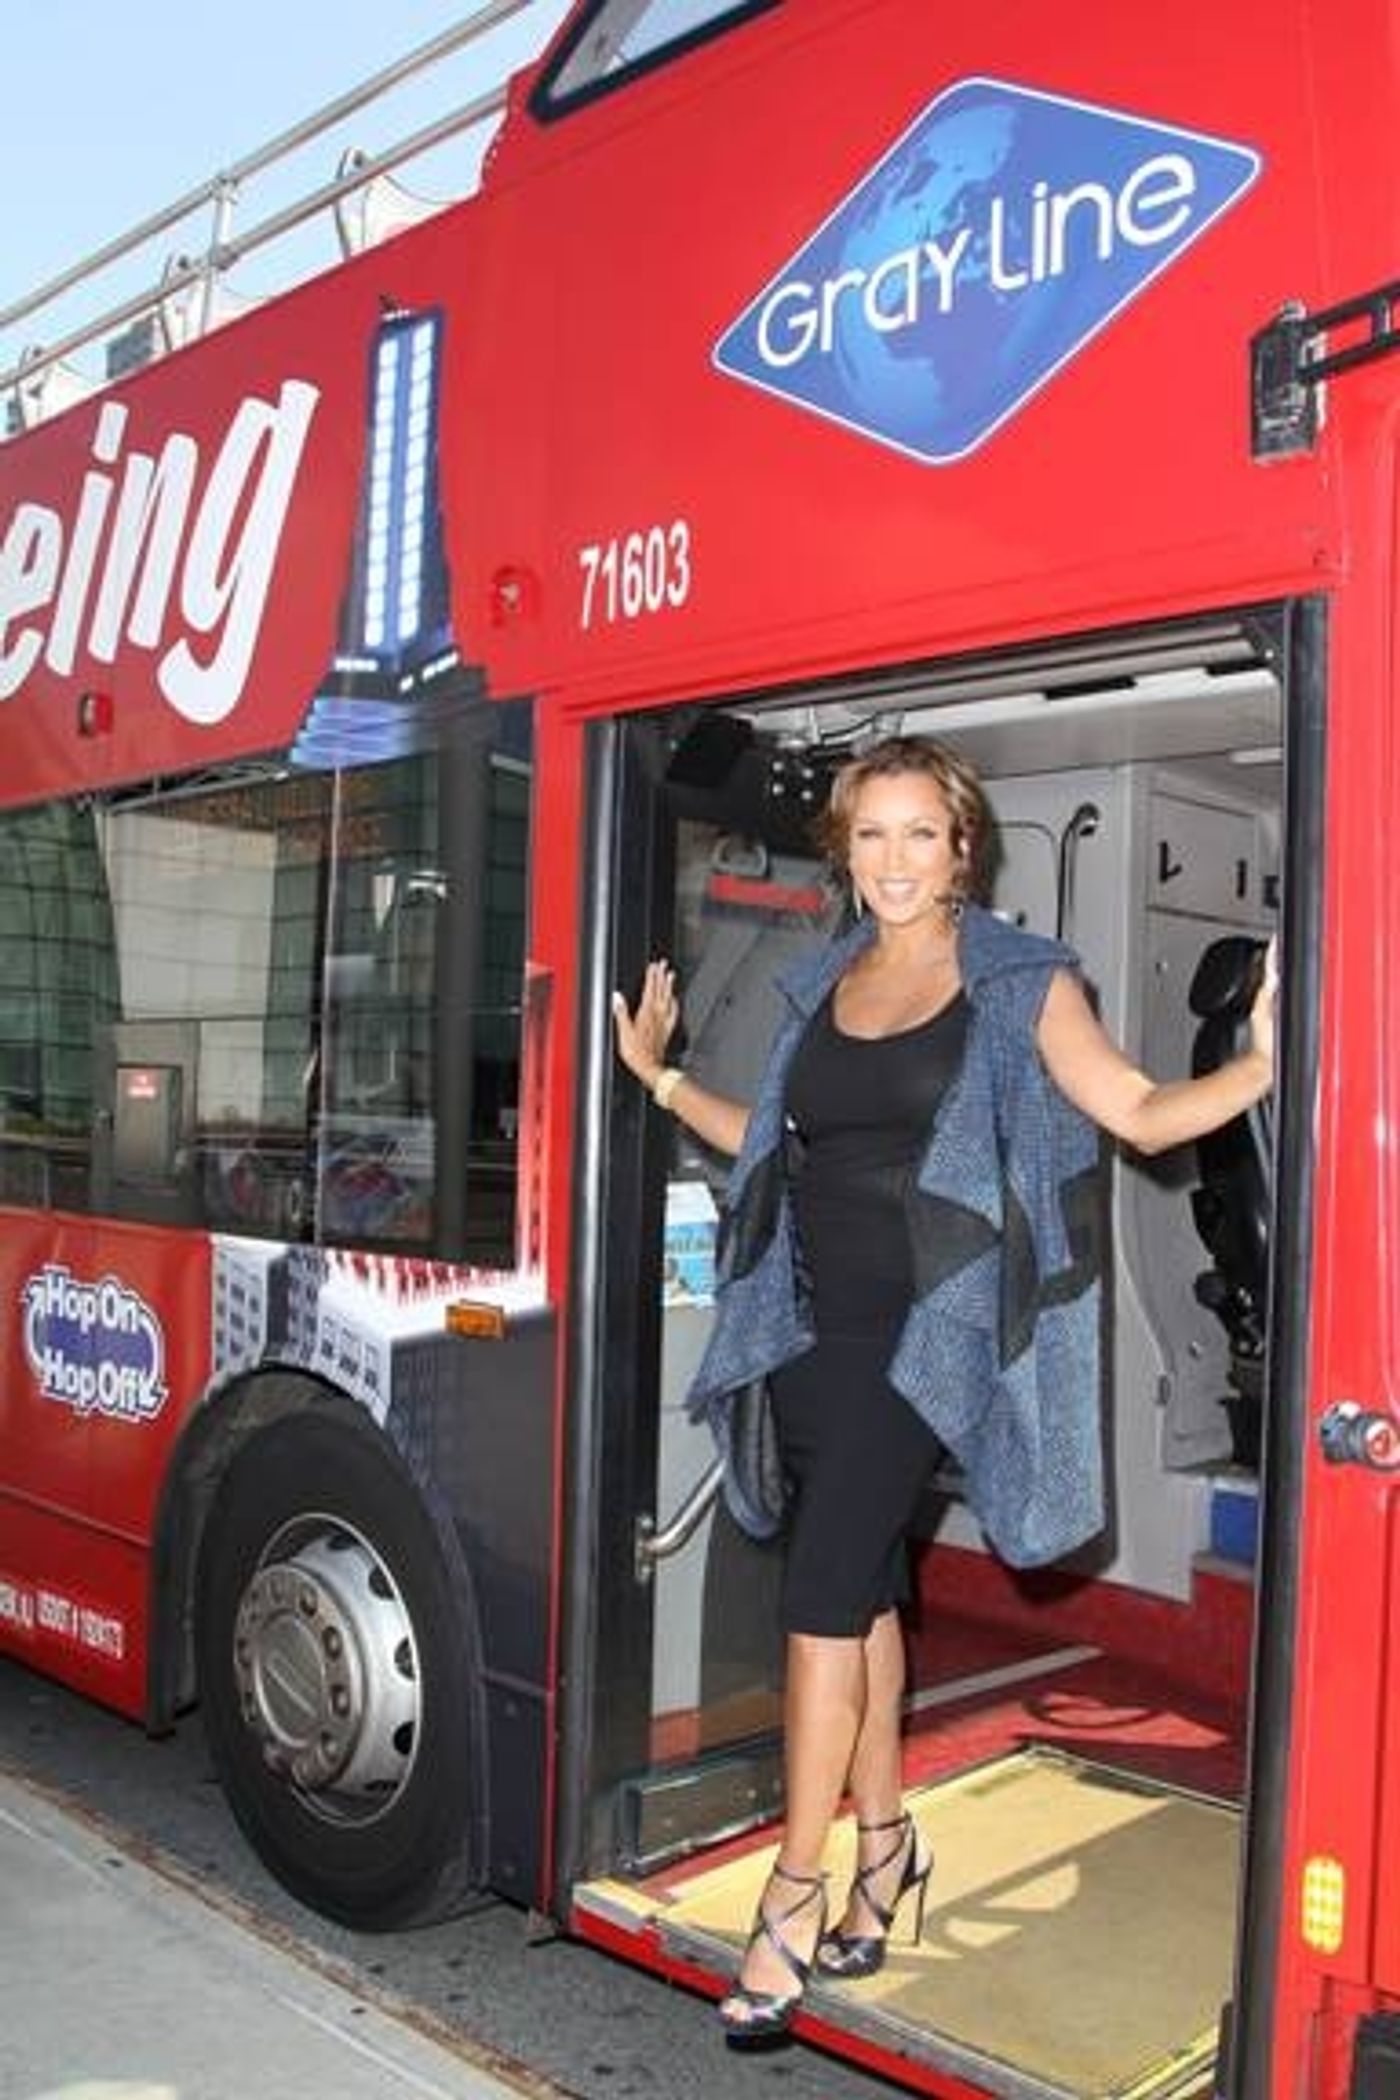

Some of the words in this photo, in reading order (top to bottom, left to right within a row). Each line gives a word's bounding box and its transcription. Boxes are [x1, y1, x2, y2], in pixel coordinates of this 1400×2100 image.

[579, 519, 690, 630] 71603
[46, 1272, 97, 1334] Hop
[101, 1283, 138, 1333] On
[44, 1347, 96, 1407] Hop
[99, 1360, 142, 1412] Off
